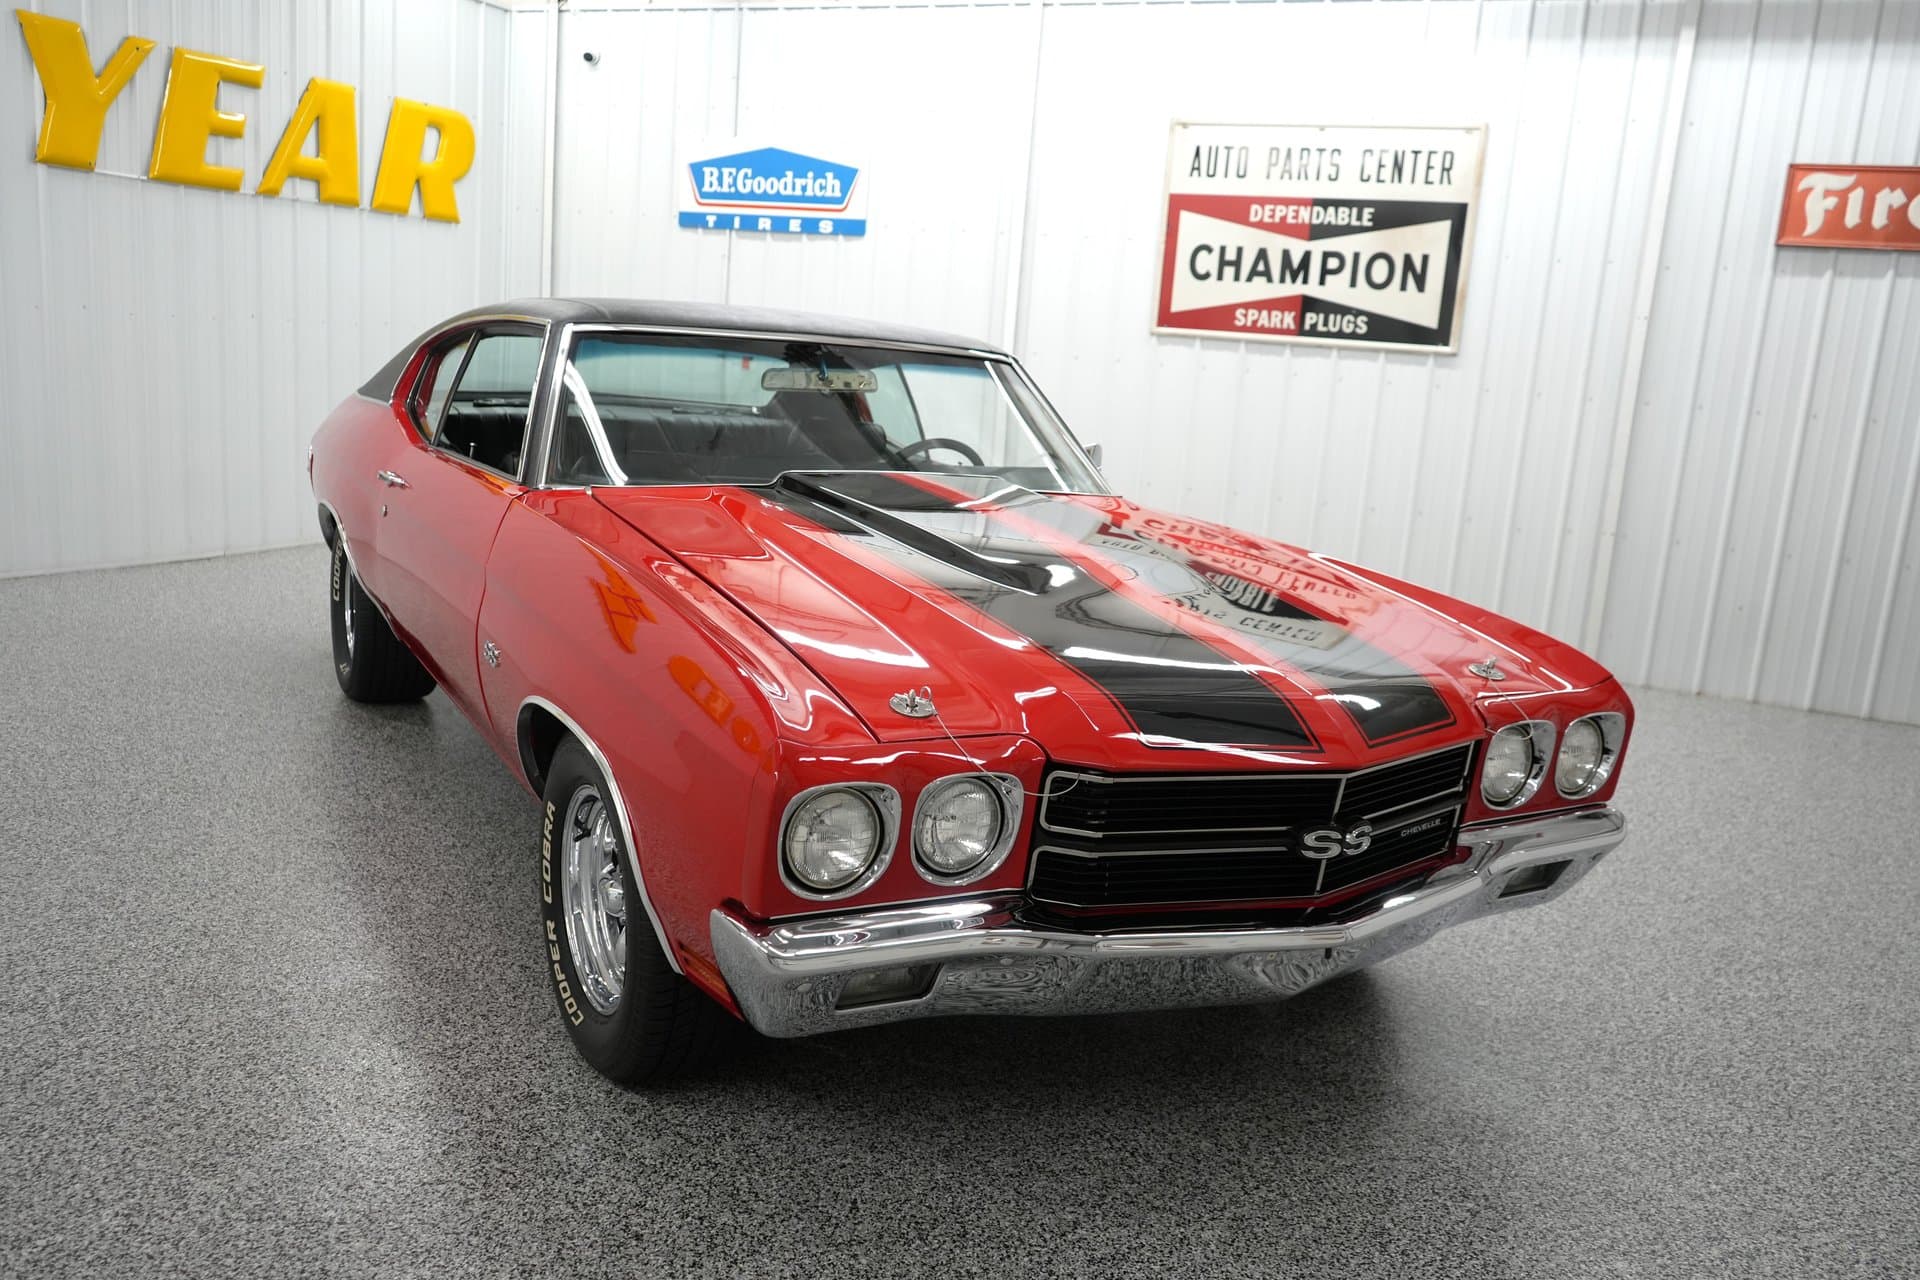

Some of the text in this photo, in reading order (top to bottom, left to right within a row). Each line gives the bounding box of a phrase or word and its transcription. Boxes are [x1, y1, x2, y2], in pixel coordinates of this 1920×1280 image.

[16, 9, 476, 223] YEAR
[1190, 145, 1456, 185] AUTO PARTS CENTER
[705, 215, 834, 234] TIRES
[1249, 203, 1375, 227] DEPENDABLE
[1189, 244, 1430, 293] CHAMPION
[1234, 308, 1369, 334] SPARK PLUGS
[1301, 825, 1373, 859] SS
[1401, 818, 1442, 838] CHEVELLE
[543, 800, 585, 1026] COOPER COBRA
